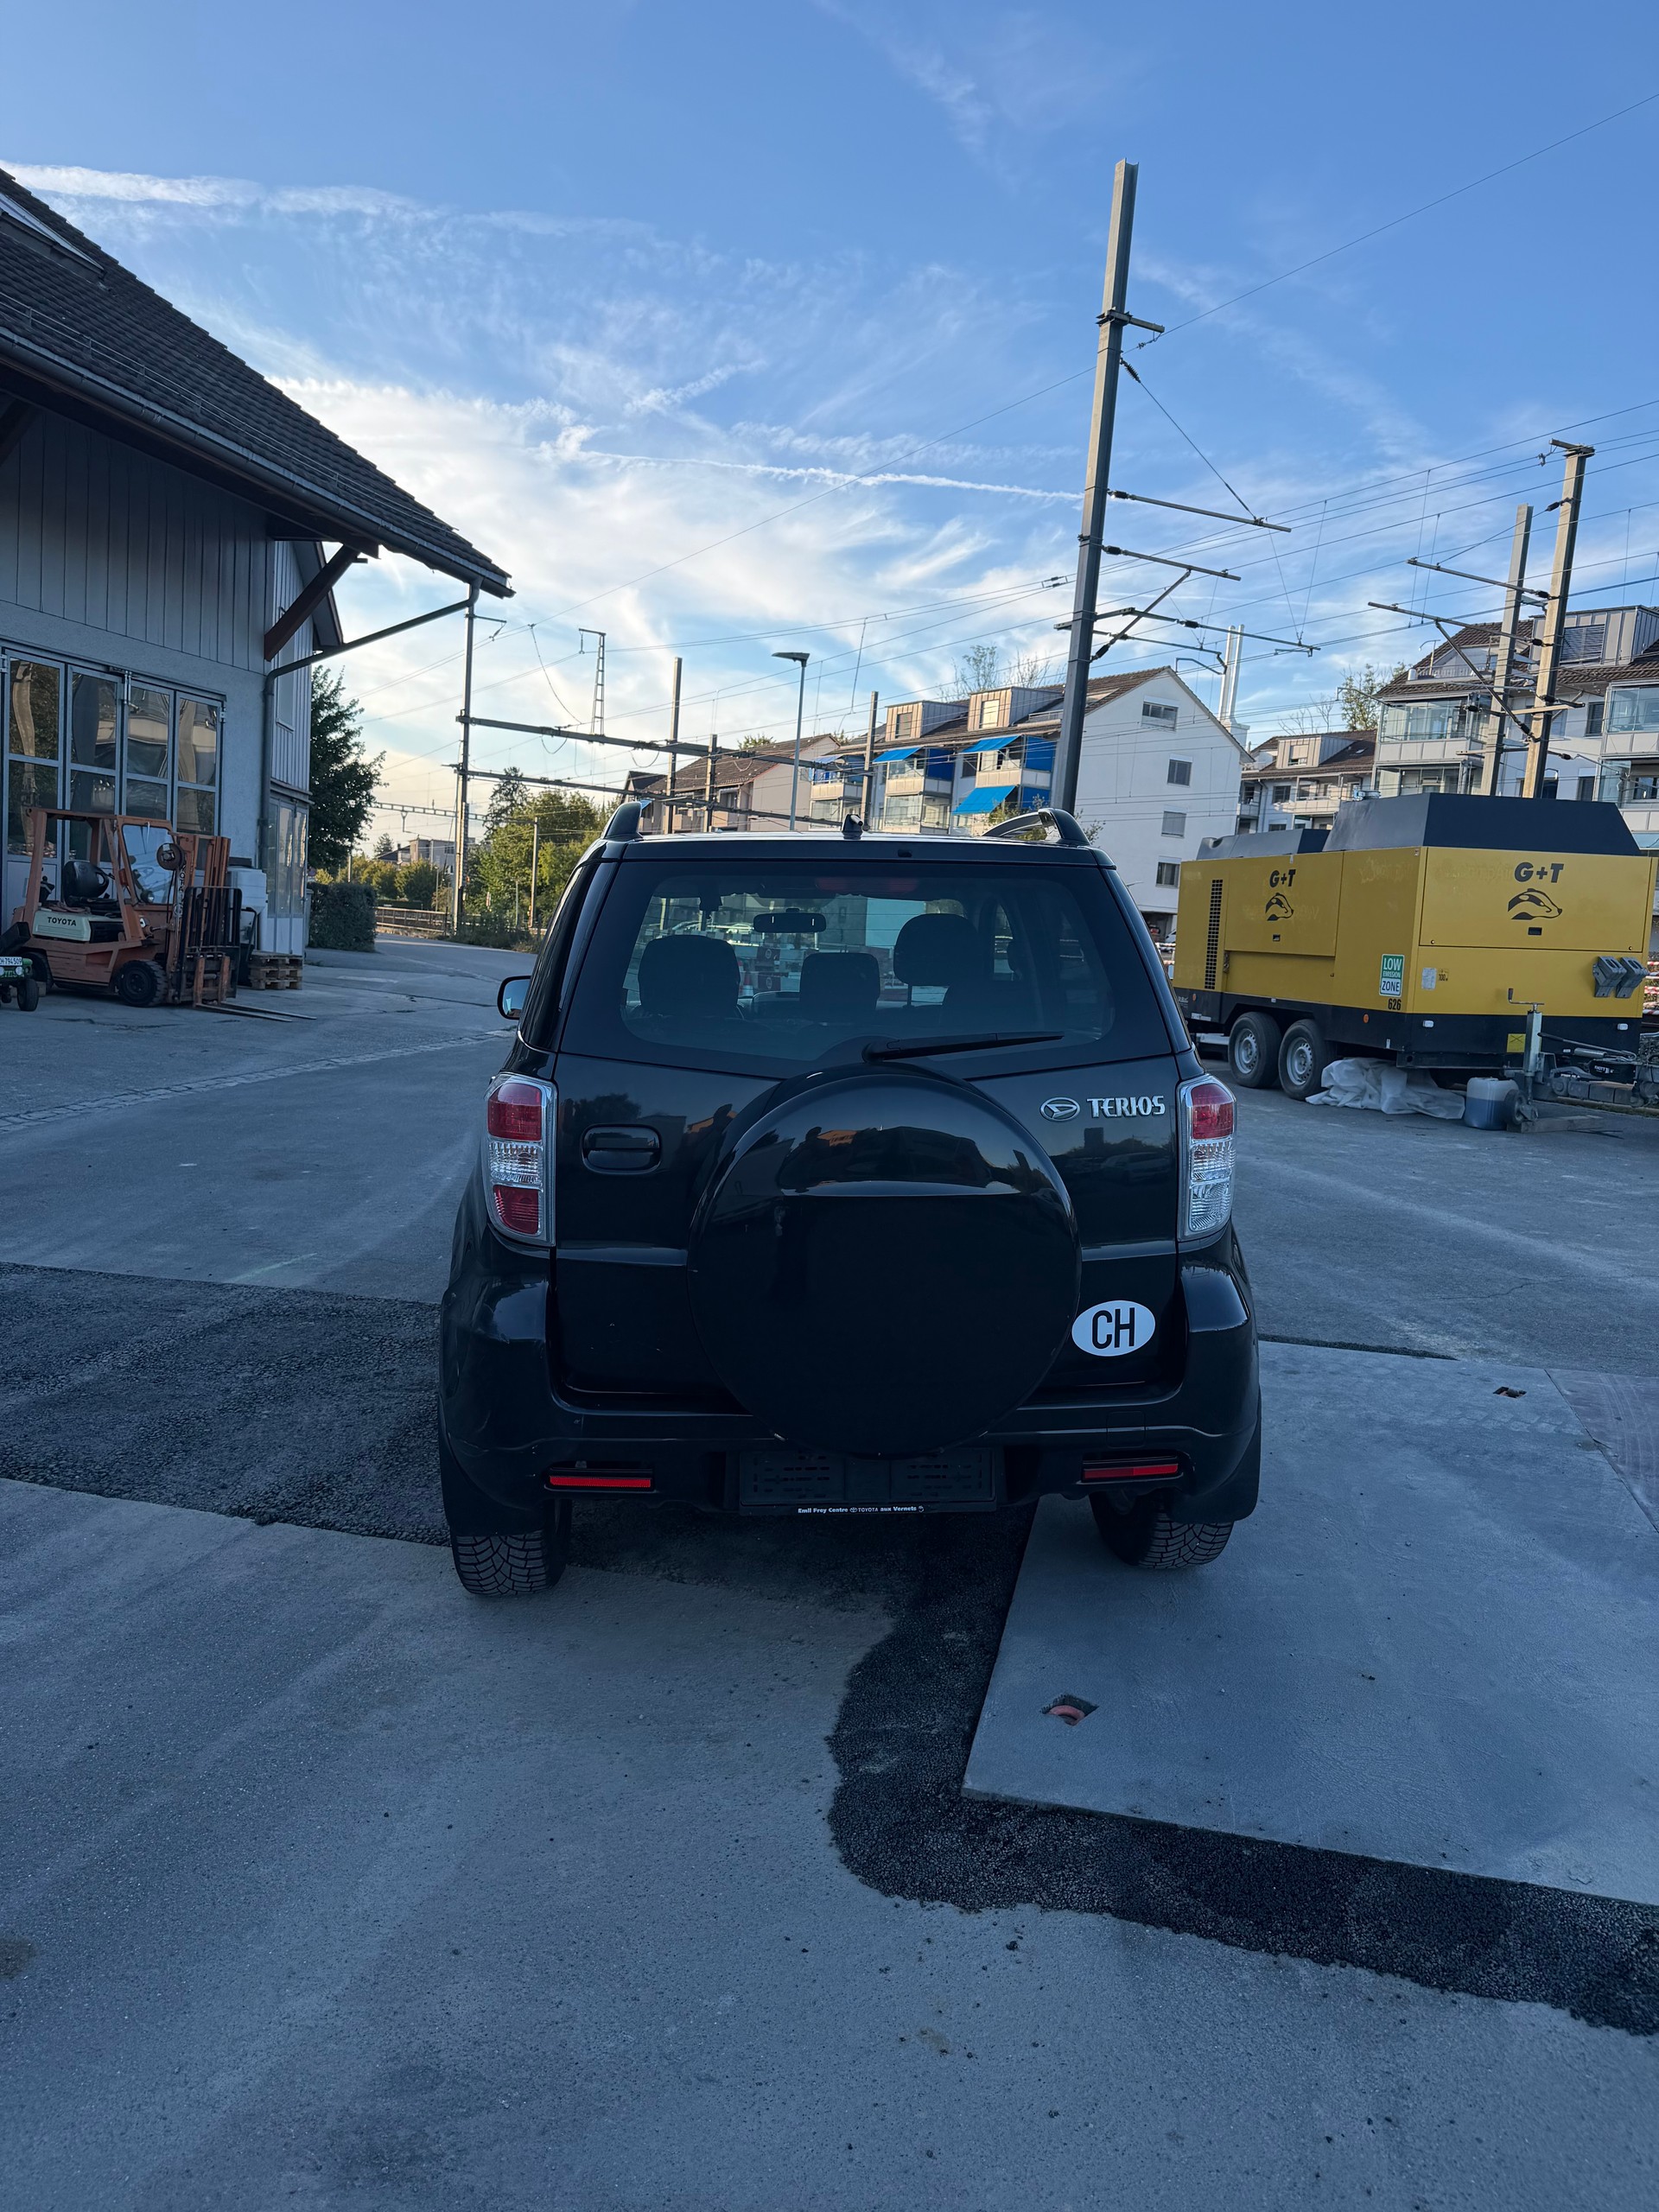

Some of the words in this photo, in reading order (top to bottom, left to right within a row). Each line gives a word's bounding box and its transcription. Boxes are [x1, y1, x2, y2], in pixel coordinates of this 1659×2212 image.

[1269, 868, 1297, 888] G+T
[1514, 861, 1565, 883] G+T
[48, 916, 77, 927] TOYOTA
[1382, 957, 1402, 971] LOW
[1382, 980, 1400, 992] ZONE
[1388, 998, 1402, 1011] 626
[1086, 1095, 1166, 1119] TERIOS
[1091, 1307, 1135, 1350] CH
